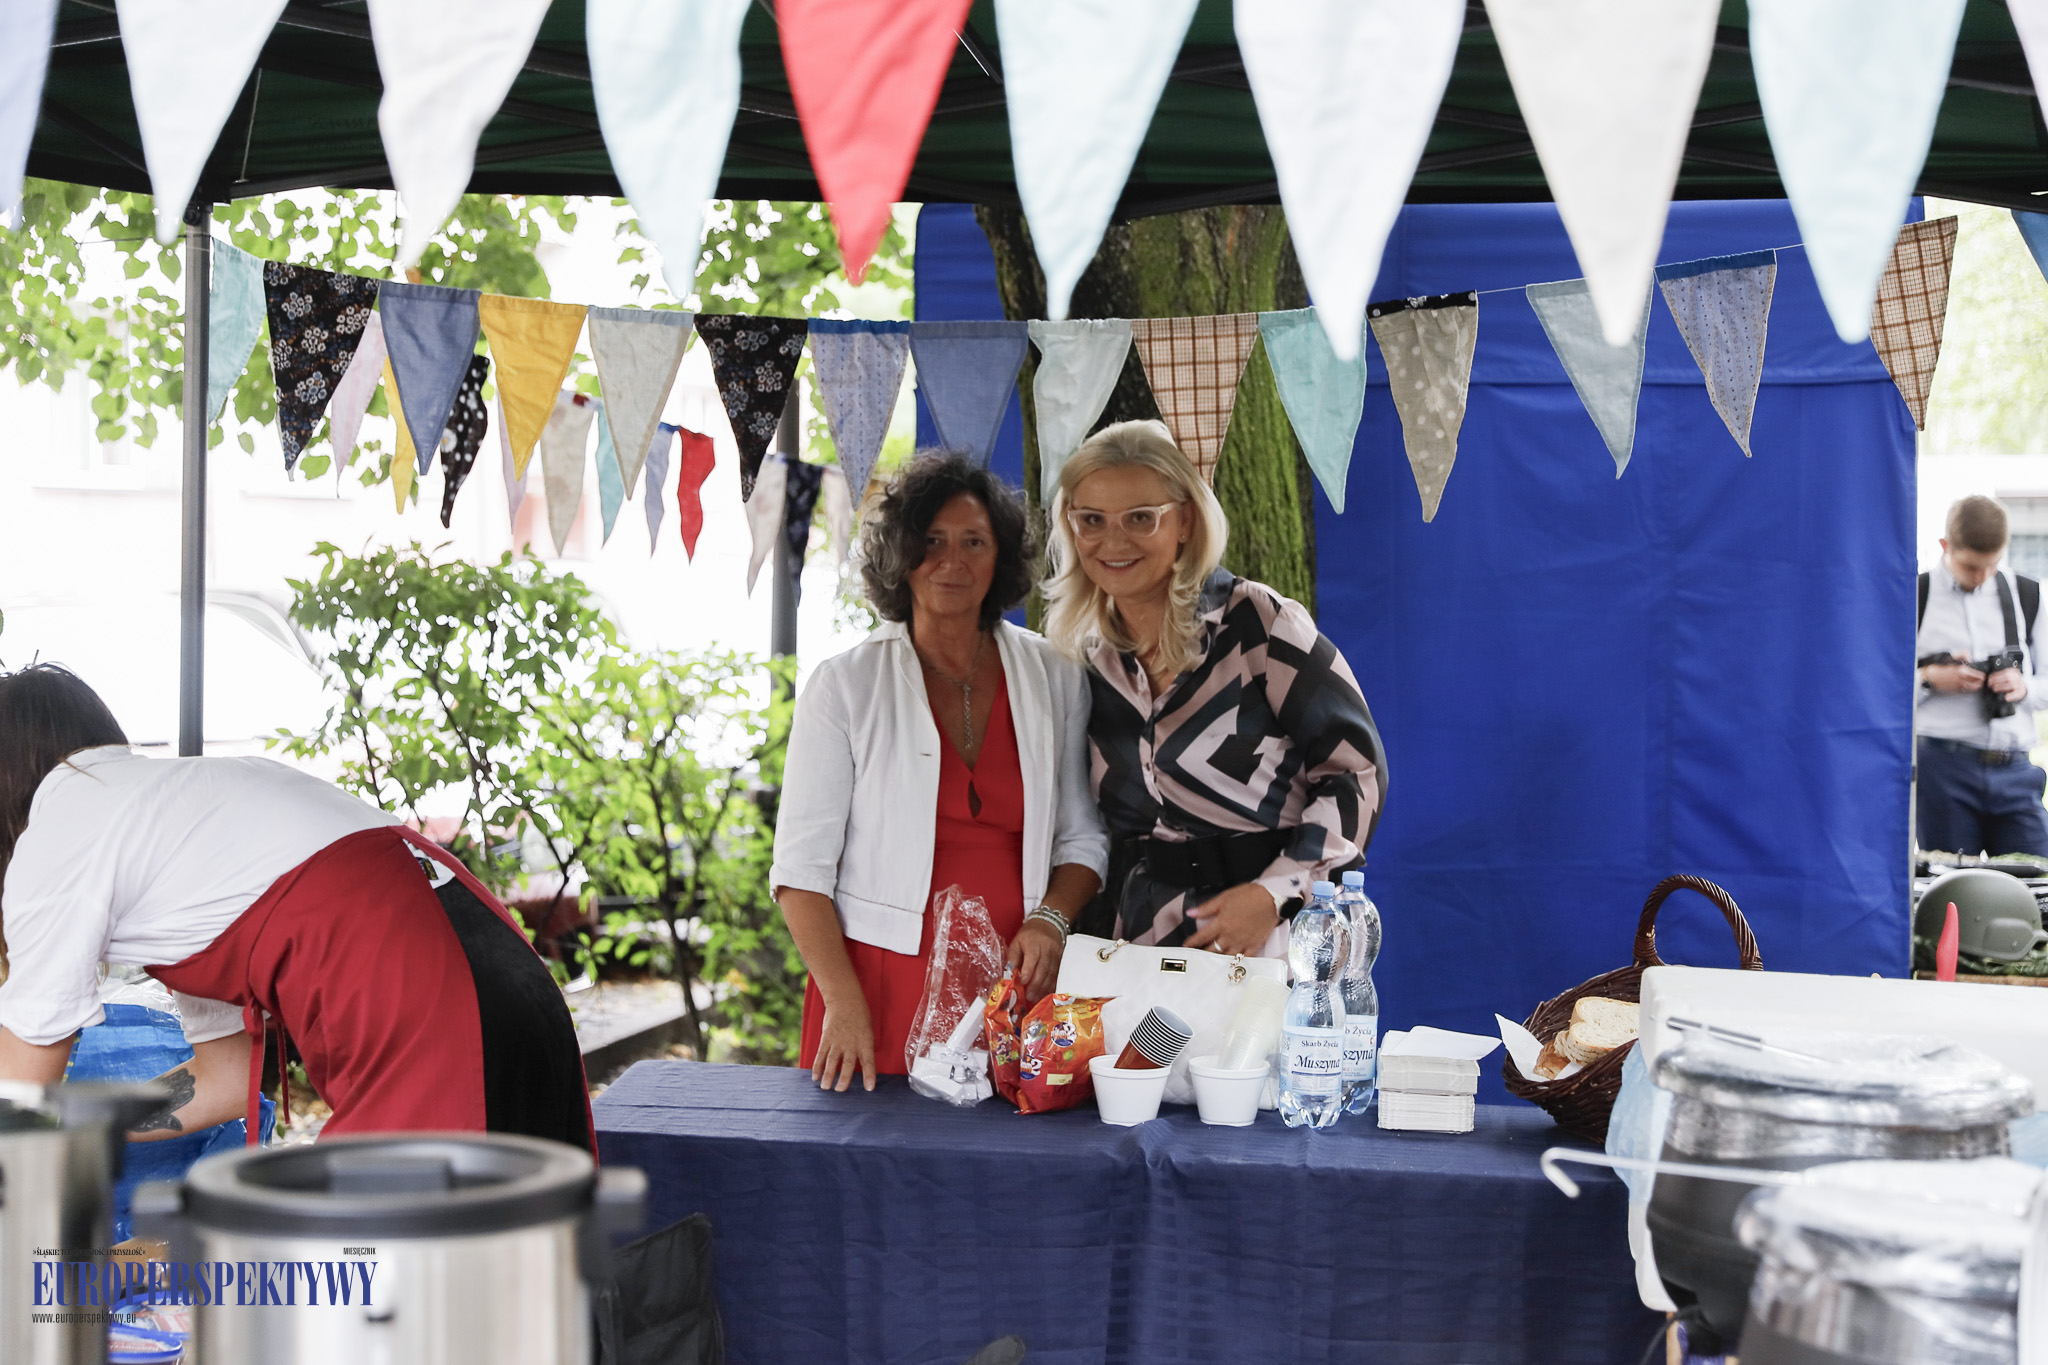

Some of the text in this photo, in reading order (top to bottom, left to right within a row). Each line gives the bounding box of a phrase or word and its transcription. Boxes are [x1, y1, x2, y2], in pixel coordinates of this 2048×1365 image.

[1323, 1040, 1339, 1048] Życia
[1294, 1054, 1340, 1073] Muszyna
[1343, 1048, 1374, 1065] szyna
